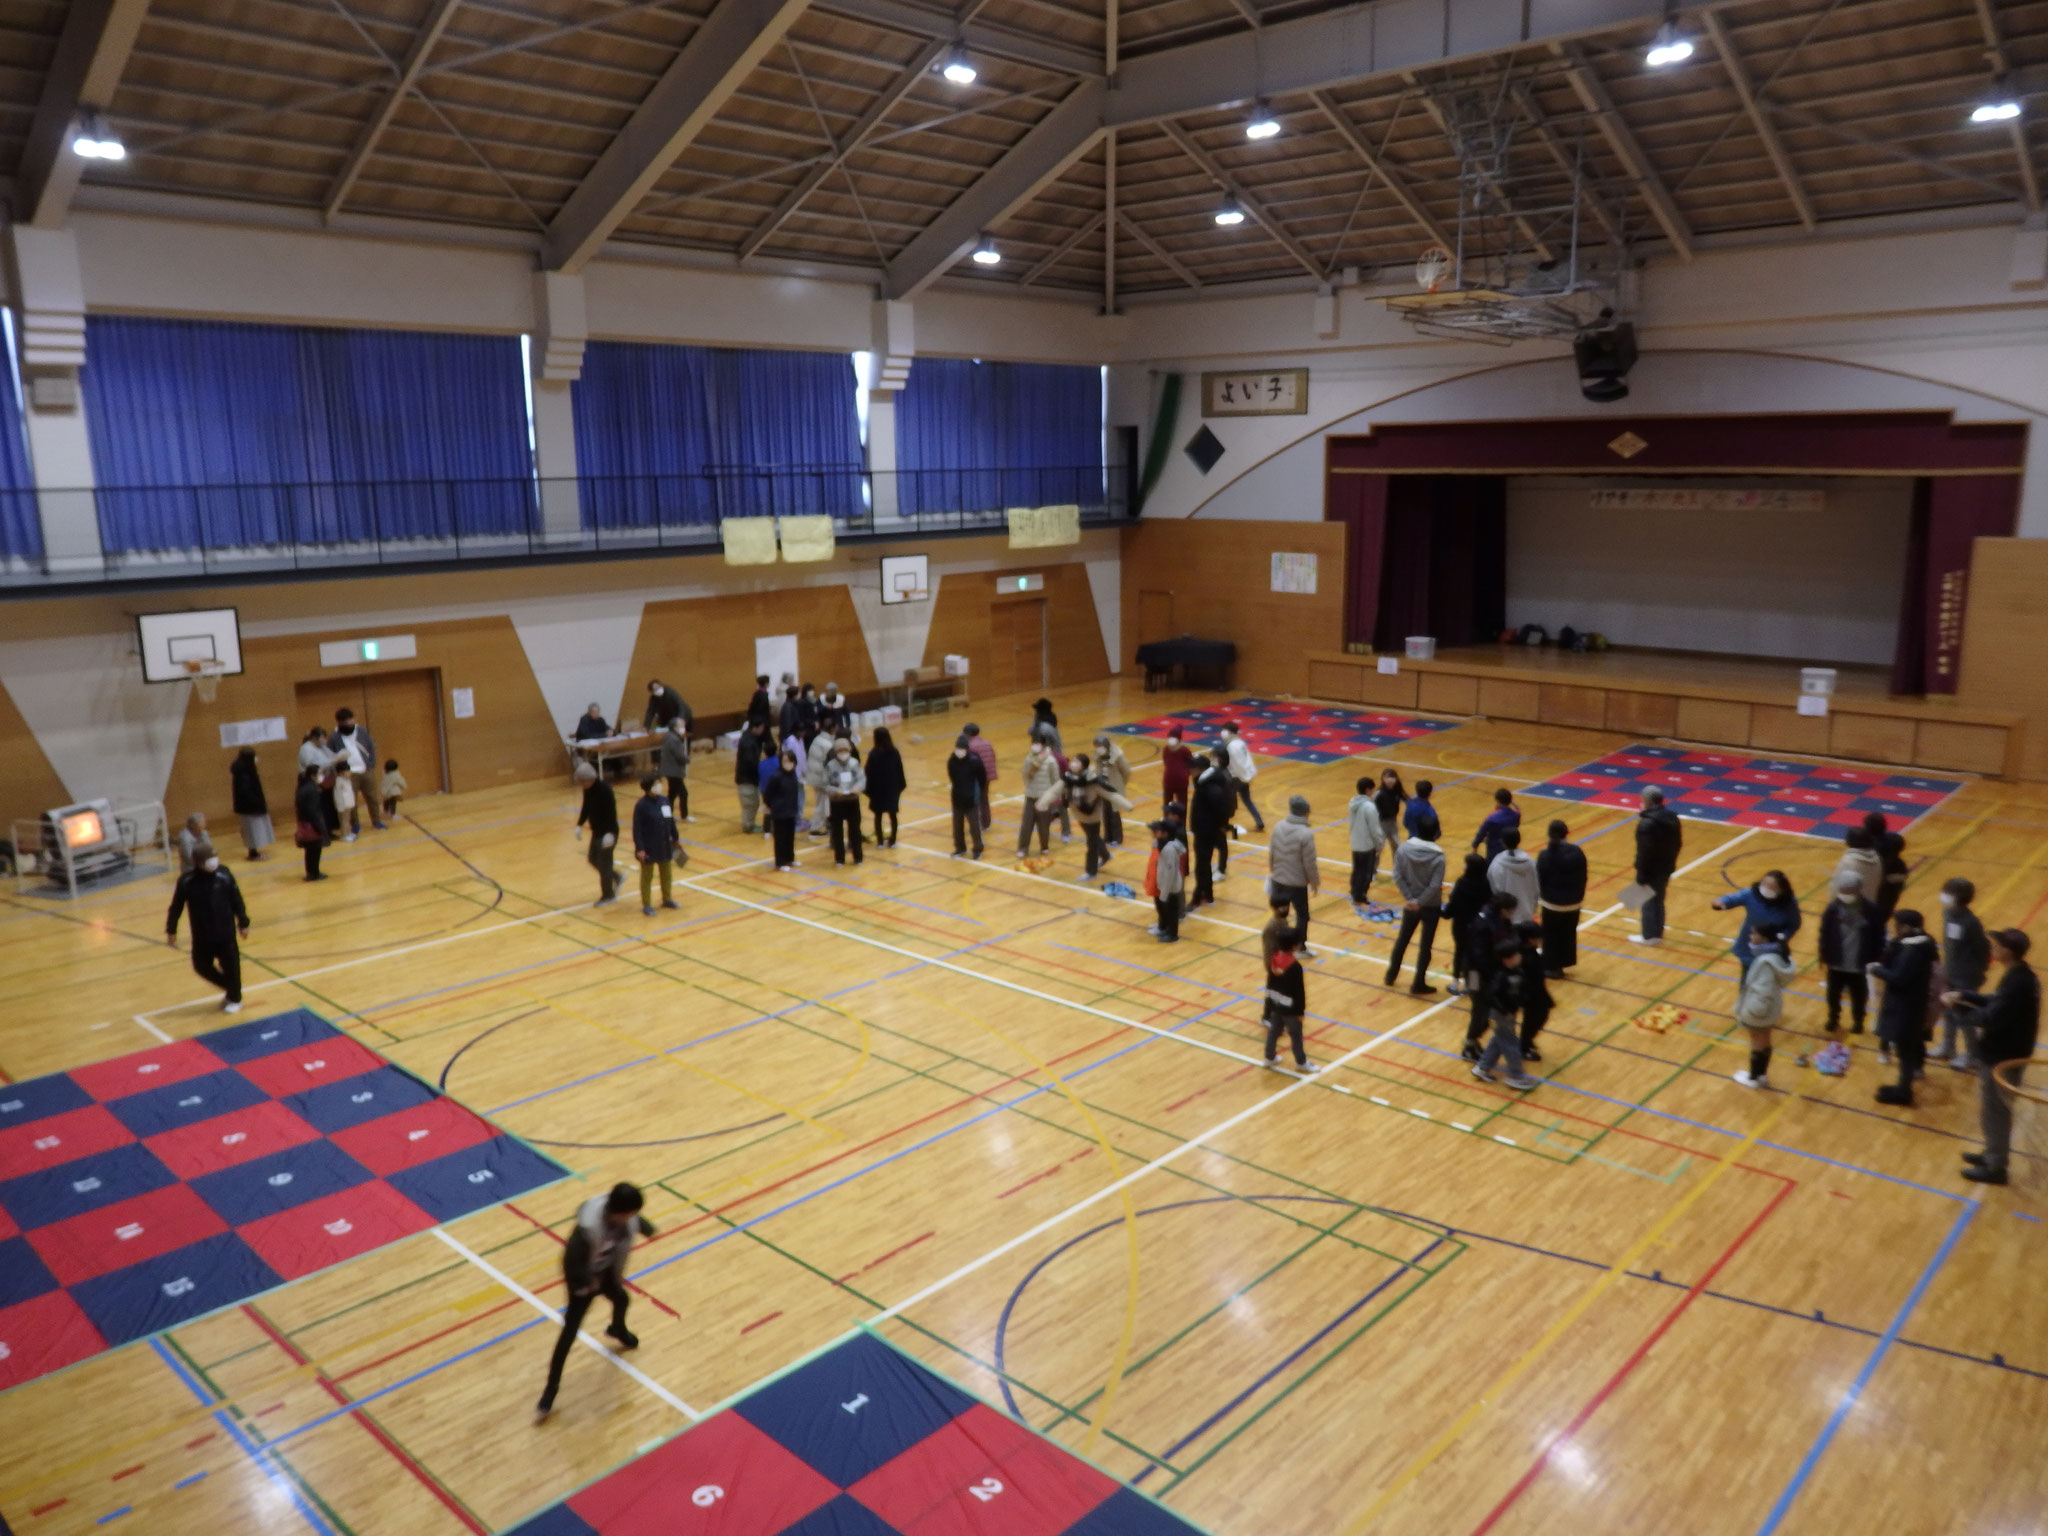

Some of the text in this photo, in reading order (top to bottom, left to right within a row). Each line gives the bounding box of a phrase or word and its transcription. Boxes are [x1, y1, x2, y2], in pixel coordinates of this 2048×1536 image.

[1221, 376, 1282, 404] よい子
[260, 1030, 279, 1041] 1
[267, 1172, 294, 1186] 9
[467, 1169, 494, 1184] 5
[323, 1217, 354, 1236] 10
[162, 1276, 195, 1297] 15
[840, 1392, 870, 1416] 1
[690, 1484, 725, 1508] 6
[968, 1476, 1005, 1503] 2
